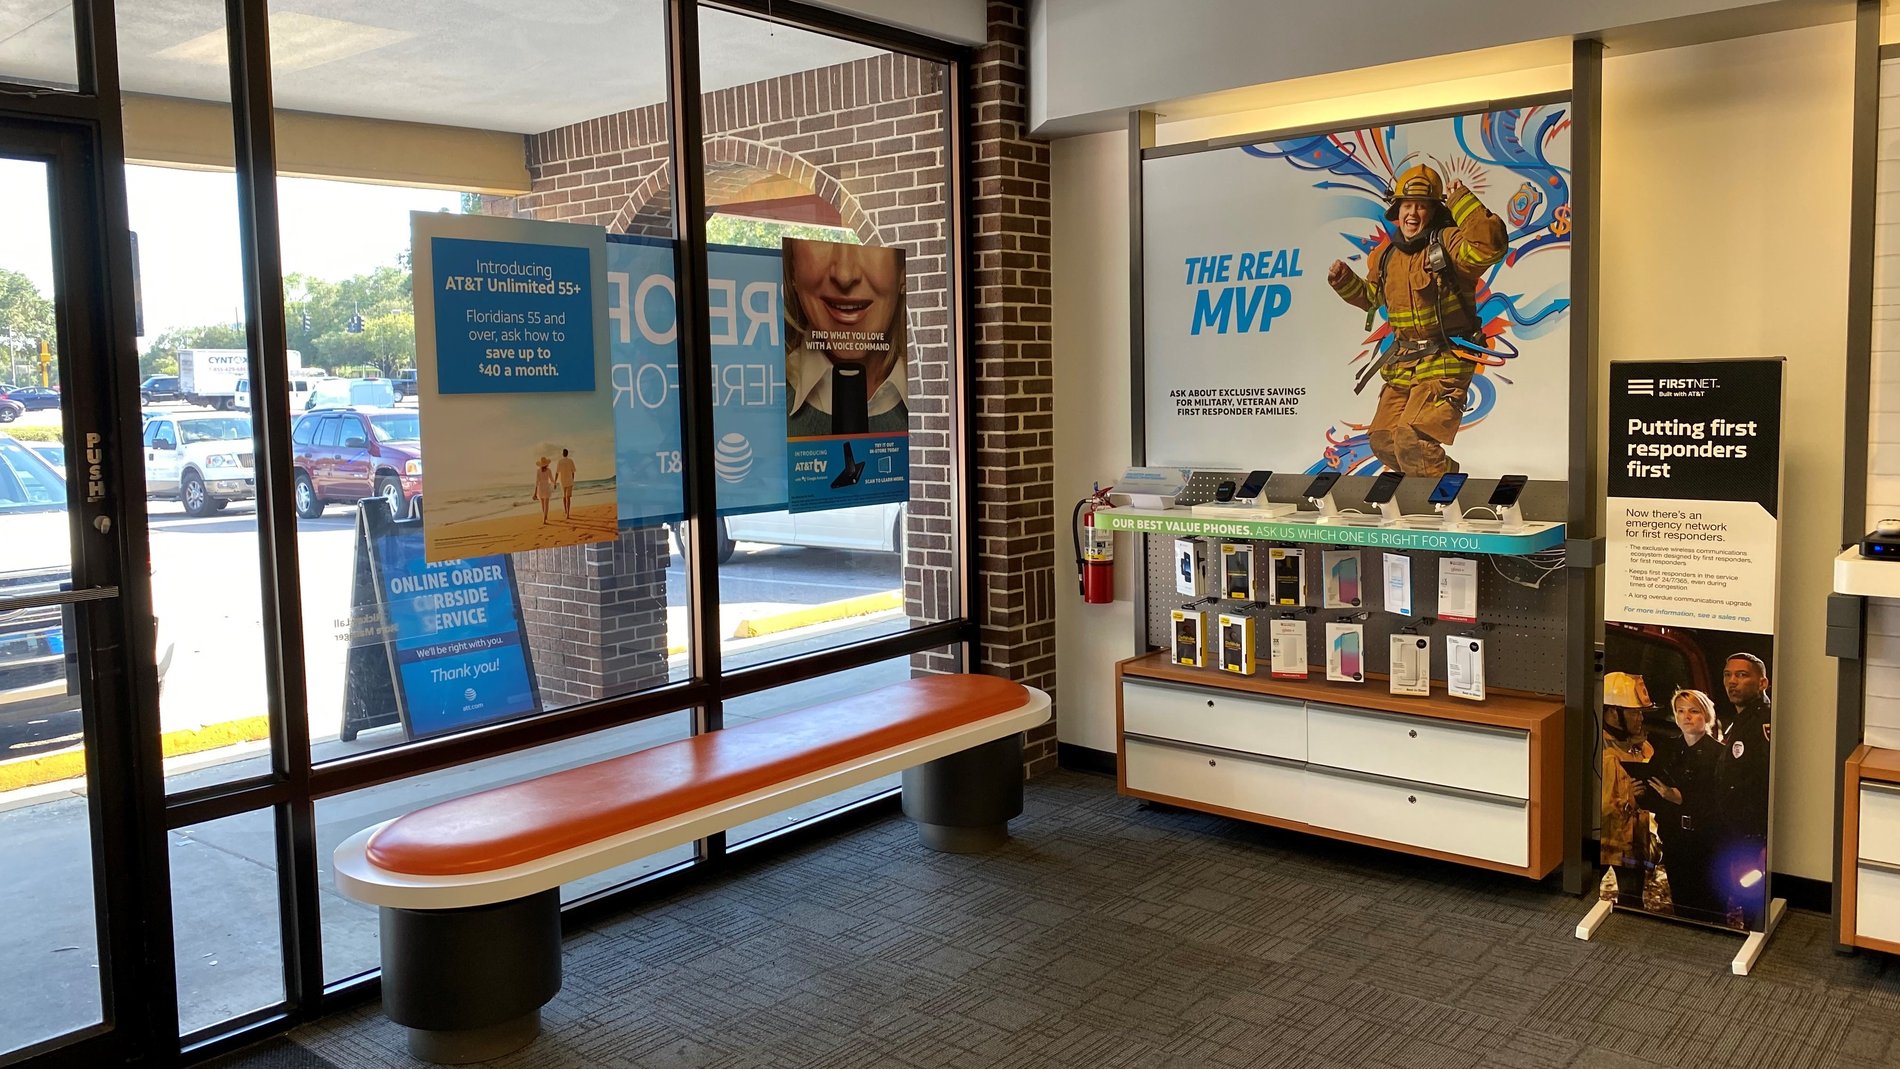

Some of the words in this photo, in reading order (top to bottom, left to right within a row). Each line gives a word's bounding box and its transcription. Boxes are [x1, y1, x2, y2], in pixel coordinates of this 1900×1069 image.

[476, 259, 552, 279] Introducing
[1185, 254, 1233, 285] THE
[1237, 248, 1303, 282] REAL
[445, 276, 483, 292] AT&T
[487, 278, 555, 295] Unlimited
[558, 282, 581, 296] 55+
[466, 309, 525, 324] Floridians
[527, 311, 541, 324] 55
[544, 312, 566, 325] and
[1190, 284, 1293, 336] MVP
[468, 329, 498, 343] over,
[501, 329, 521, 342] ask
[524, 329, 550, 342] how
[552, 330, 565, 342] to
[811, 330, 829, 339] FIND
[829, 331, 851, 340] WHAT
[851, 332, 866, 340] YOU
[867, 332, 885, 341] LOVE
[805, 341, 825, 350] WITH
[826, 342, 832, 350] A
[832, 342, 854, 351] VOICE
[854, 343, 890, 351] COMMAND
[485, 348, 515, 359] save
[518, 349, 535, 362] up
[537, 347, 551, 359] to
[478, 363, 501, 377] $40
[504, 366, 512, 377] a
[1169, 389, 1187, 398] ASK
[1188, 389, 1217, 397] ABOUT
[1218, 388, 1265, 397] EXCLUSIVE
[1267, 387, 1306, 396] SAVINGS
[1176, 398, 1193, 407] FOR
[1194, 398, 1235, 407] MILITARY,
[1236, 397, 1277, 406] VETERAN
[1278, 397, 1299, 406] AND
[1177, 408, 1201, 416] FIRST
[1202, 407, 1253, 416] RESPONDER
[1255, 407, 1298, 416] FAMILIES.
[1628, 418, 1706, 440] Putting
[1710, 418, 1757, 437] first
[794, 449, 828, 457] INTRODUCING
[1627, 440, 1747, 460] responders
[86, 432, 105, 497] PUSH
[1626, 460, 1671, 478] first
[1626, 508, 1649, 518] Now
[1652, 509, 1686, 520] there's
[1689, 512, 1702, 520] an
[1625, 520, 1682, 531] emergency
[1685, 522, 1728, 531] network
[1112, 518, 1135, 529] OUR
[1137, 519, 1163, 531] BEST
[1165, 521, 1201, 533] VALUE
[1203, 523, 1253, 536] PHONES.
[1255, 525, 1277, 537] ASK
[1280, 527, 1295, 538] US
[1297, 528, 1336, 541] WHICH
[1339, 530, 1364, 543] ONE
[1368, 532, 1378, 544] IS
[1381, 533, 1419, 546] RIGHT
[1422, 535, 1447, 548] FOR
[1451, 537, 1481, 550] YOU.
[1625, 528, 1639, 538] for
[1642, 529, 1661, 539] first
[1663, 531, 1726, 542] responders.
[1663, 552, 1692, 561] designed
[1693, 553, 1701, 561] by
[1696, 548, 1748, 556] communications
[1652, 558, 1687, 566] responders
[391, 571, 449, 594] ONLINE
[452, 565, 503, 586] ORDER
[1661, 570, 1696, 578] responders
[1654, 583, 1688, 591] congestion
[1707, 579, 1727, 588] during
[414, 587, 490, 612] CURBSIDE
[1673, 596, 1724, 605] communications
[1725, 599, 1752, 607] upgrade
[425, 608, 487, 632] SERVICE
[1655, 608, 1696, 618] information,
[1717, 613, 1736, 621] sales
[1737, 615, 1752, 623] rep.
[416, 648, 436, 658] We'll
[436, 646, 447, 655] be
[448, 643, 468, 654] right
[468, 639, 487, 650] with
[486, 637, 503, 648] you.
[430, 663, 471, 683] Thank
[473, 657, 500, 679] you!
[463, 703, 484, 712] att.com
